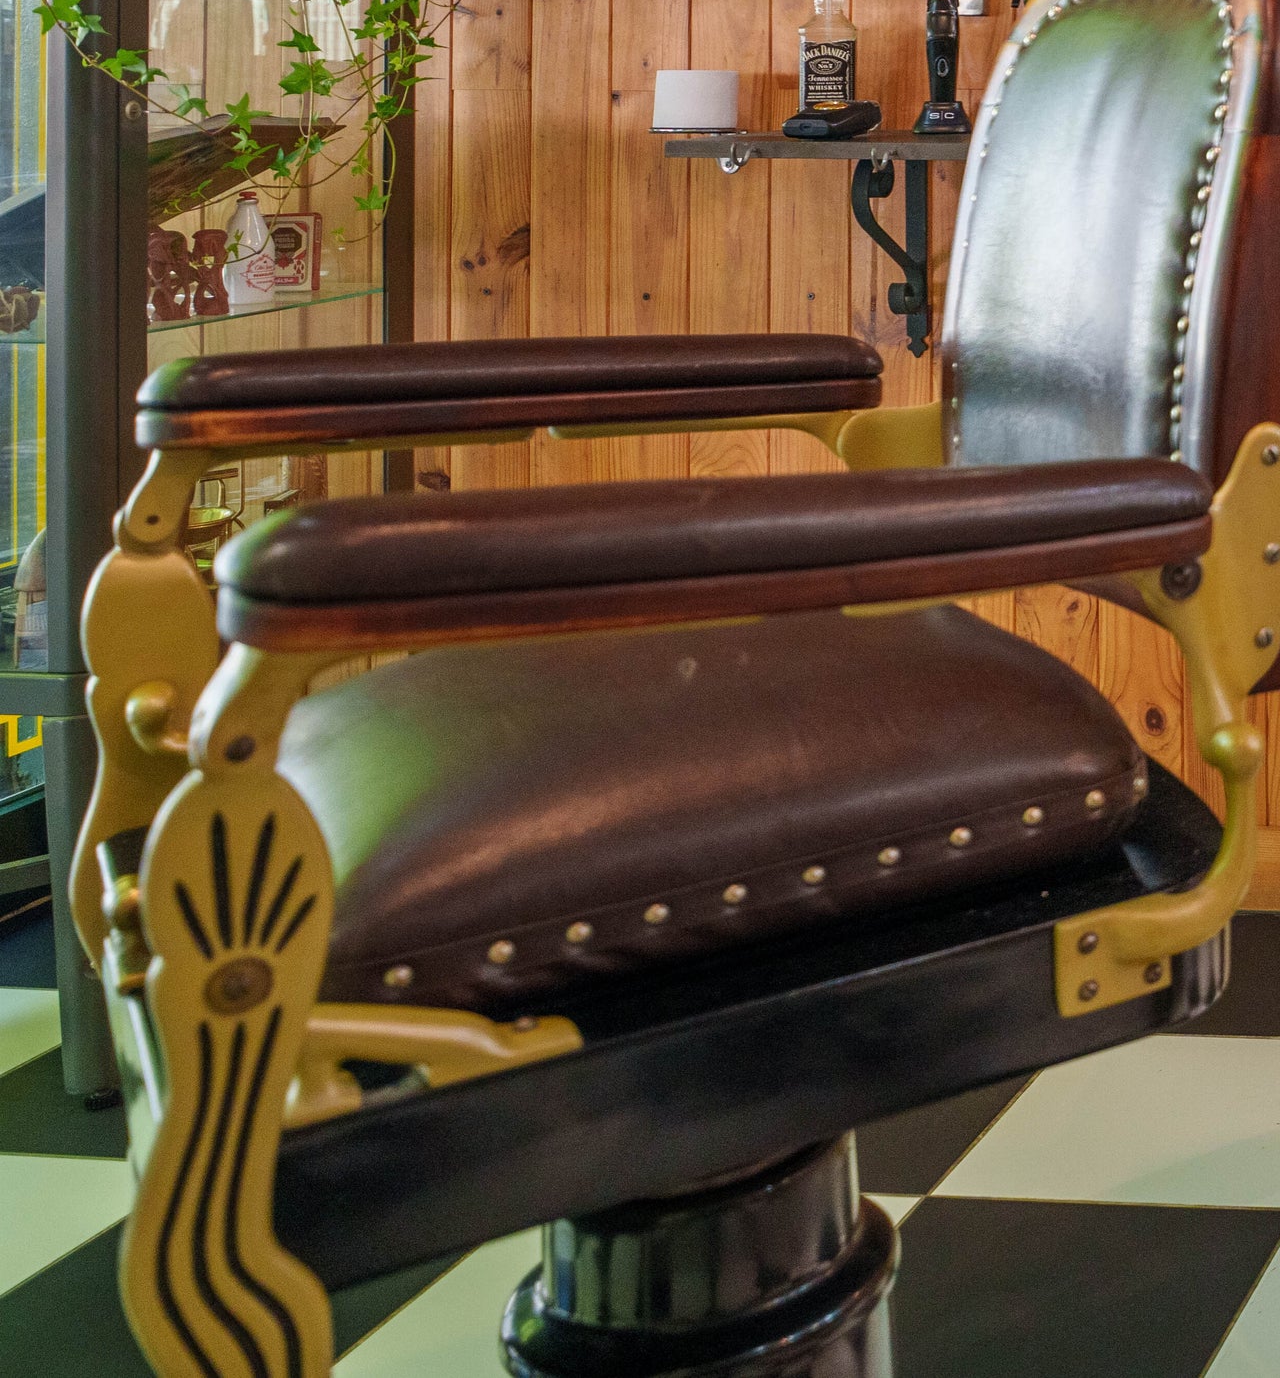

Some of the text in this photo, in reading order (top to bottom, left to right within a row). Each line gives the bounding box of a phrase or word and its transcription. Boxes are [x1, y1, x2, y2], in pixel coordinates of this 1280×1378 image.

[802, 44, 850, 62] JACK DANIEL'S
[807, 74, 844, 82] Tennessee
